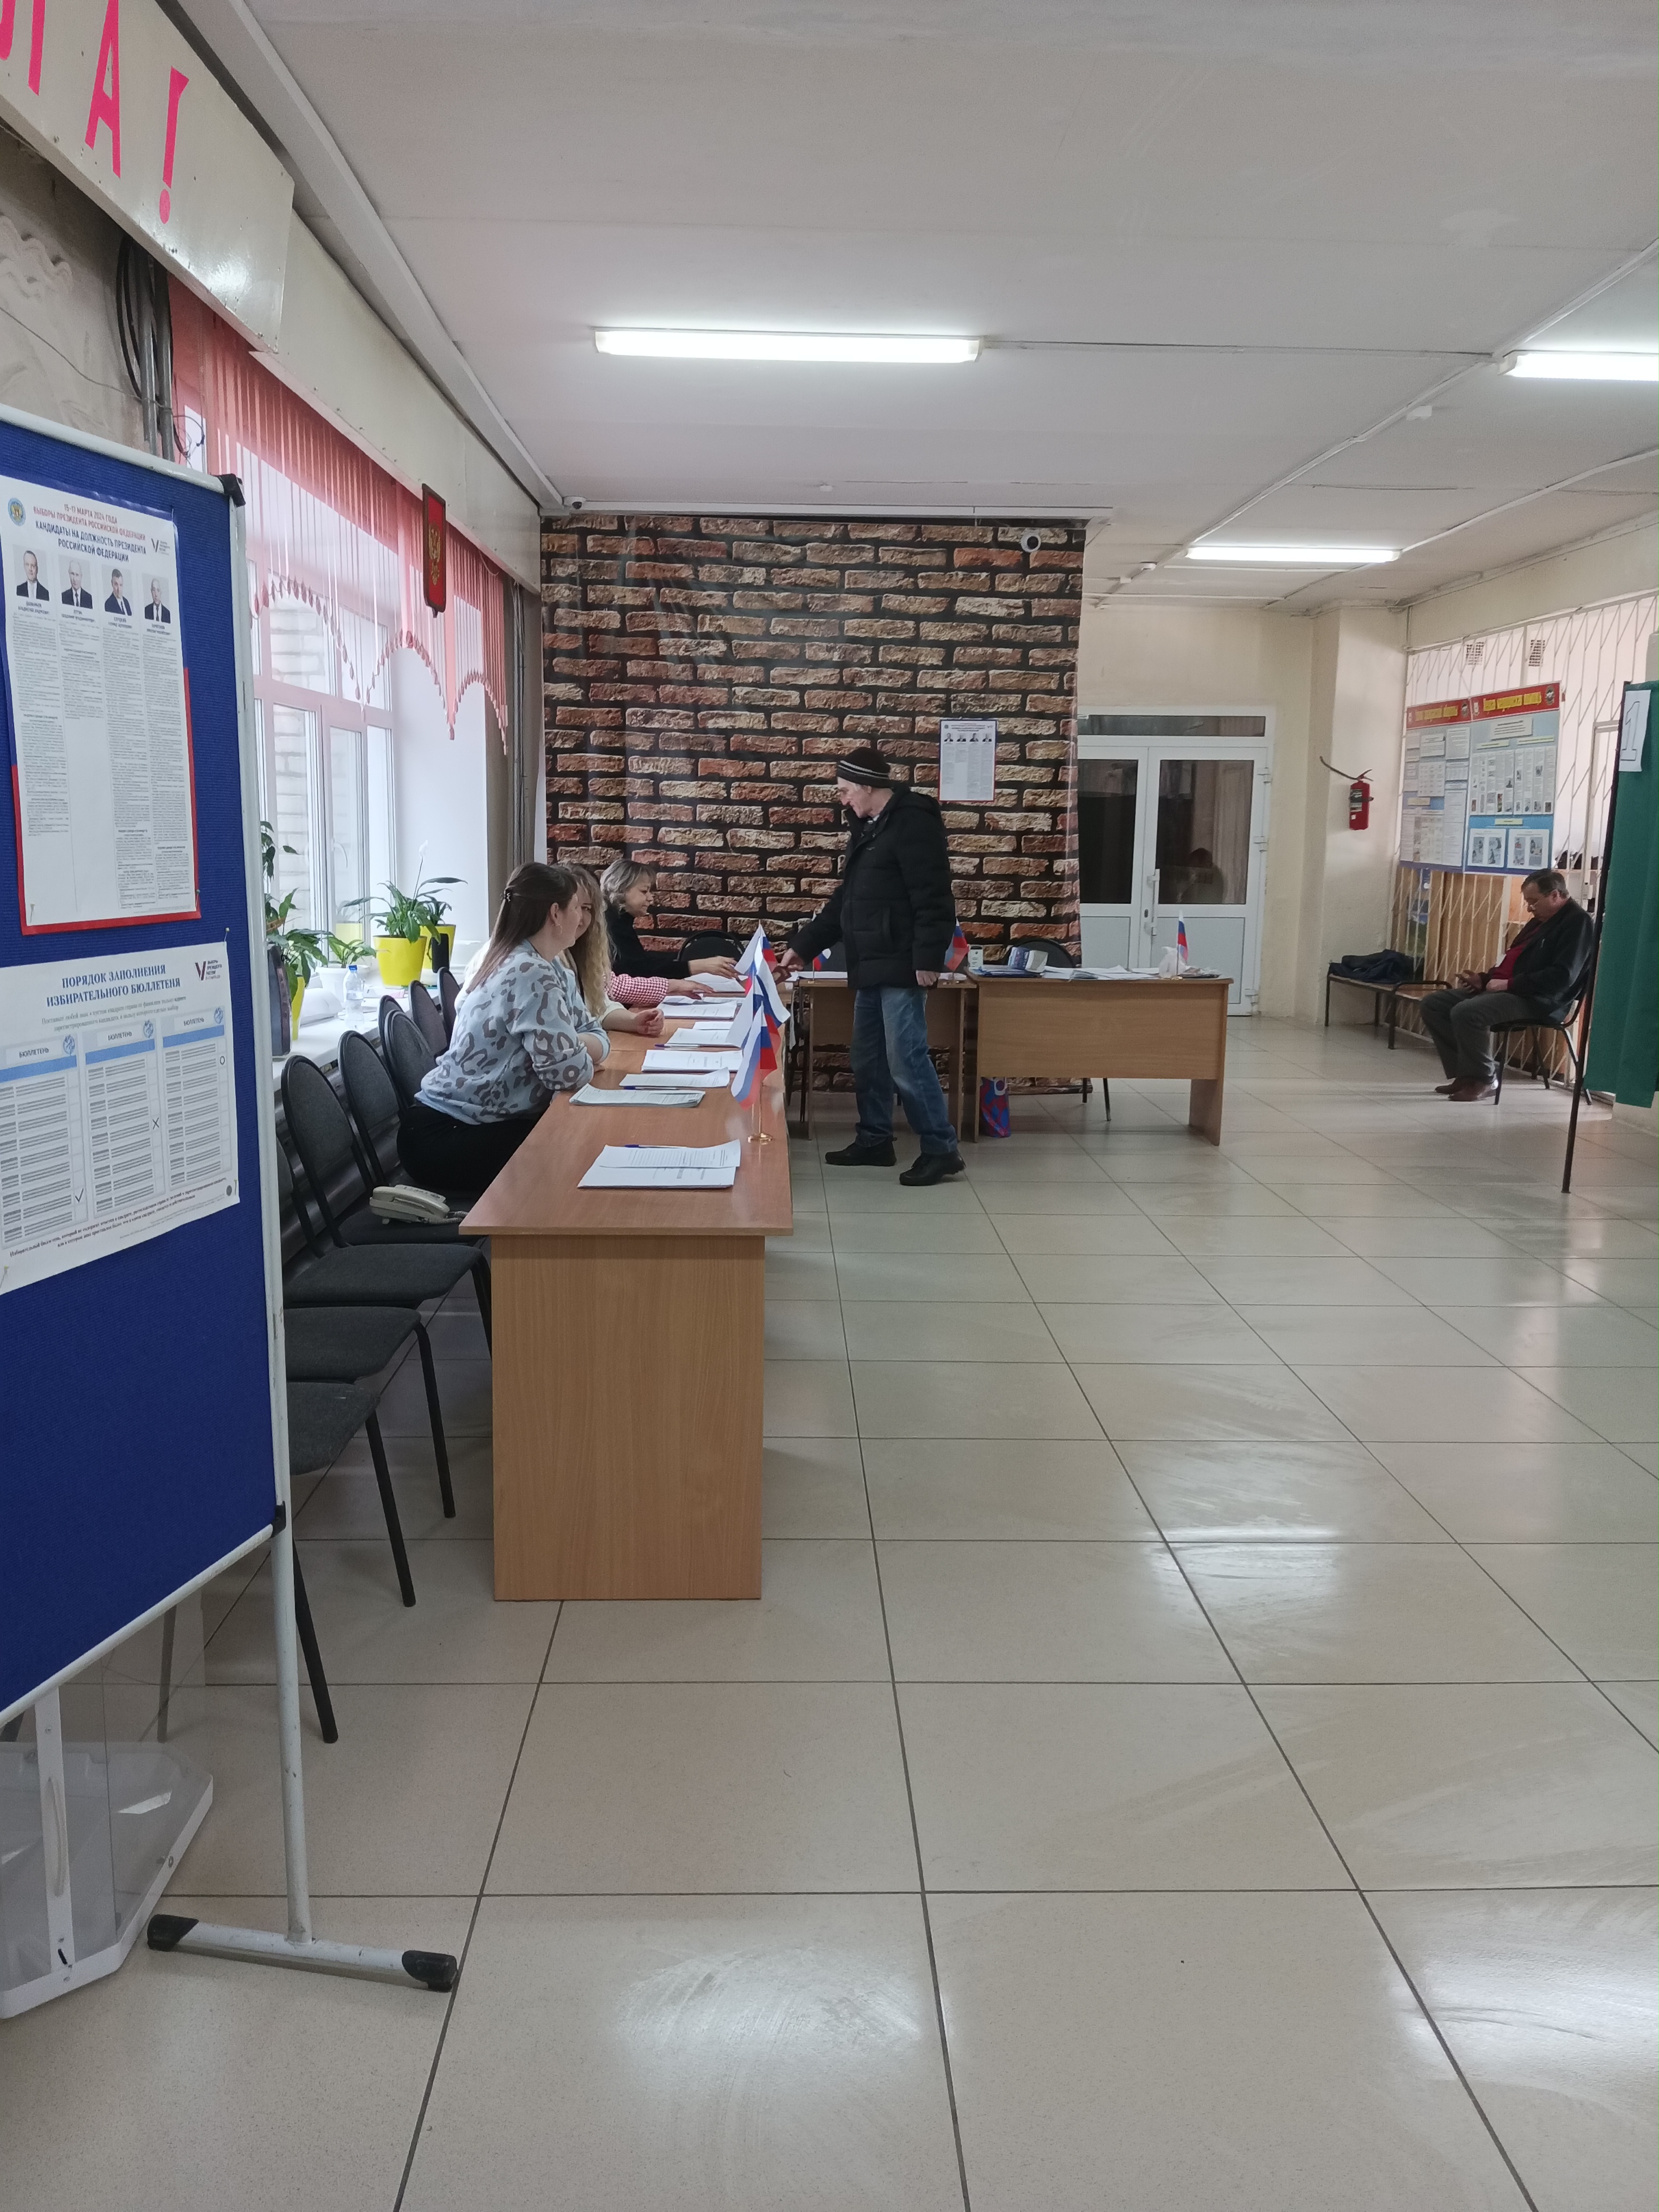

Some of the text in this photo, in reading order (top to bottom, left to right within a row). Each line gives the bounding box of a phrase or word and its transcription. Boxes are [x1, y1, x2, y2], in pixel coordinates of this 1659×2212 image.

[33, 506, 146, 540] ВЫБОРЫ ПРЕЗИДЕНТА РОССИЙСКОЙ ФЕДЕРАЦИИ
[77, 507, 93, 518] МАРТА
[106, 514, 118, 524] ГОДА
[35, 520, 71, 537] КАНДИДАТЫ
[71, 529, 79, 538] НА
[80, 531, 114, 547] ДОЛЖНОСТЬ
[114, 539, 146, 555] ПРЕЗИДЕНТА
[58, 538, 129, 562] РОССИЙСКОЙ ФЕДЕРАЦИИ
[1620, 701, 1640, 761] 1
[62, 964, 165, 988] ПОРЯДОК ЗАПОЛНЕНИЯ
[46, 978, 181, 1007] ИЗБИРАТЕЛЬНОГО БЮЛЛЕТЕНЯ
[108, 1031, 132, 1041] БЮЛЛЕТЕНЬ
[19, 1047, 50, 1058] БЮЛЛЕТЕНЬ
